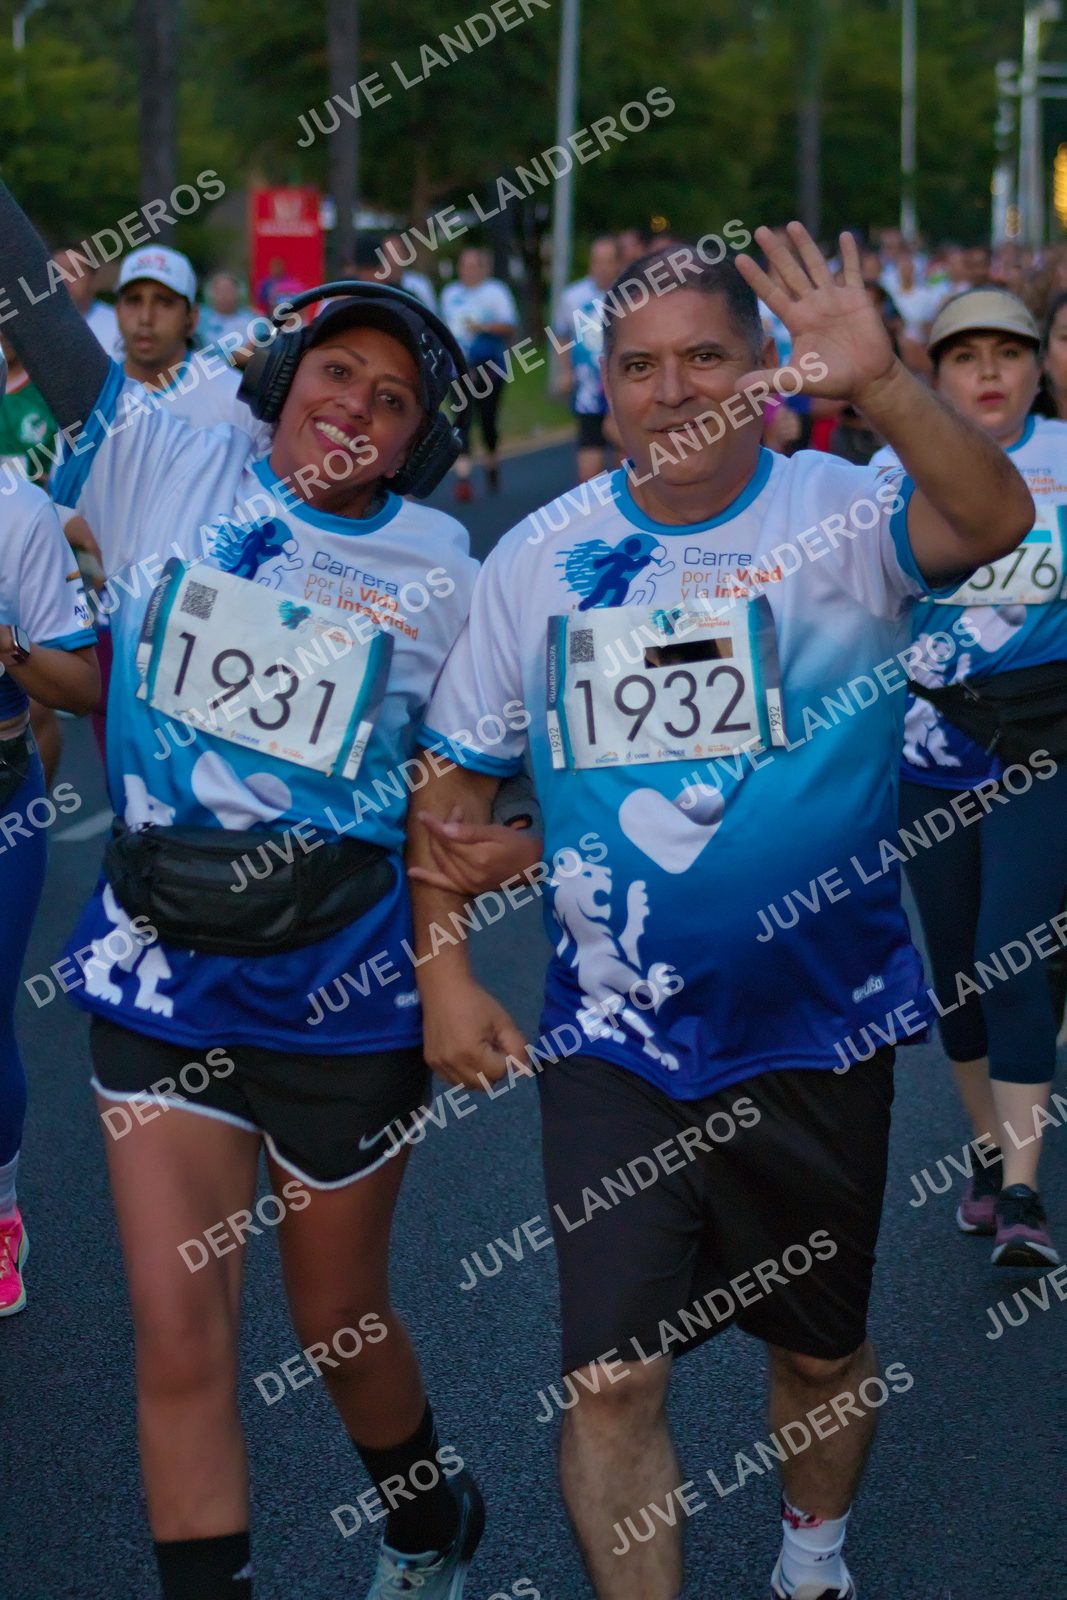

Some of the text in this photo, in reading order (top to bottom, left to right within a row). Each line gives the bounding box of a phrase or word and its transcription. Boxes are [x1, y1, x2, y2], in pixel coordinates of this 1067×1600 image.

[305, 573, 399, 613] por la Vida
[311, 551, 399, 596] Carrera
[682, 571, 712, 586] por
[336, 595, 419, 641] Integridad
[174, 631, 337, 746] 1931
[575, 666, 751, 745] 1932
[549, 727, 562, 754] 1932
